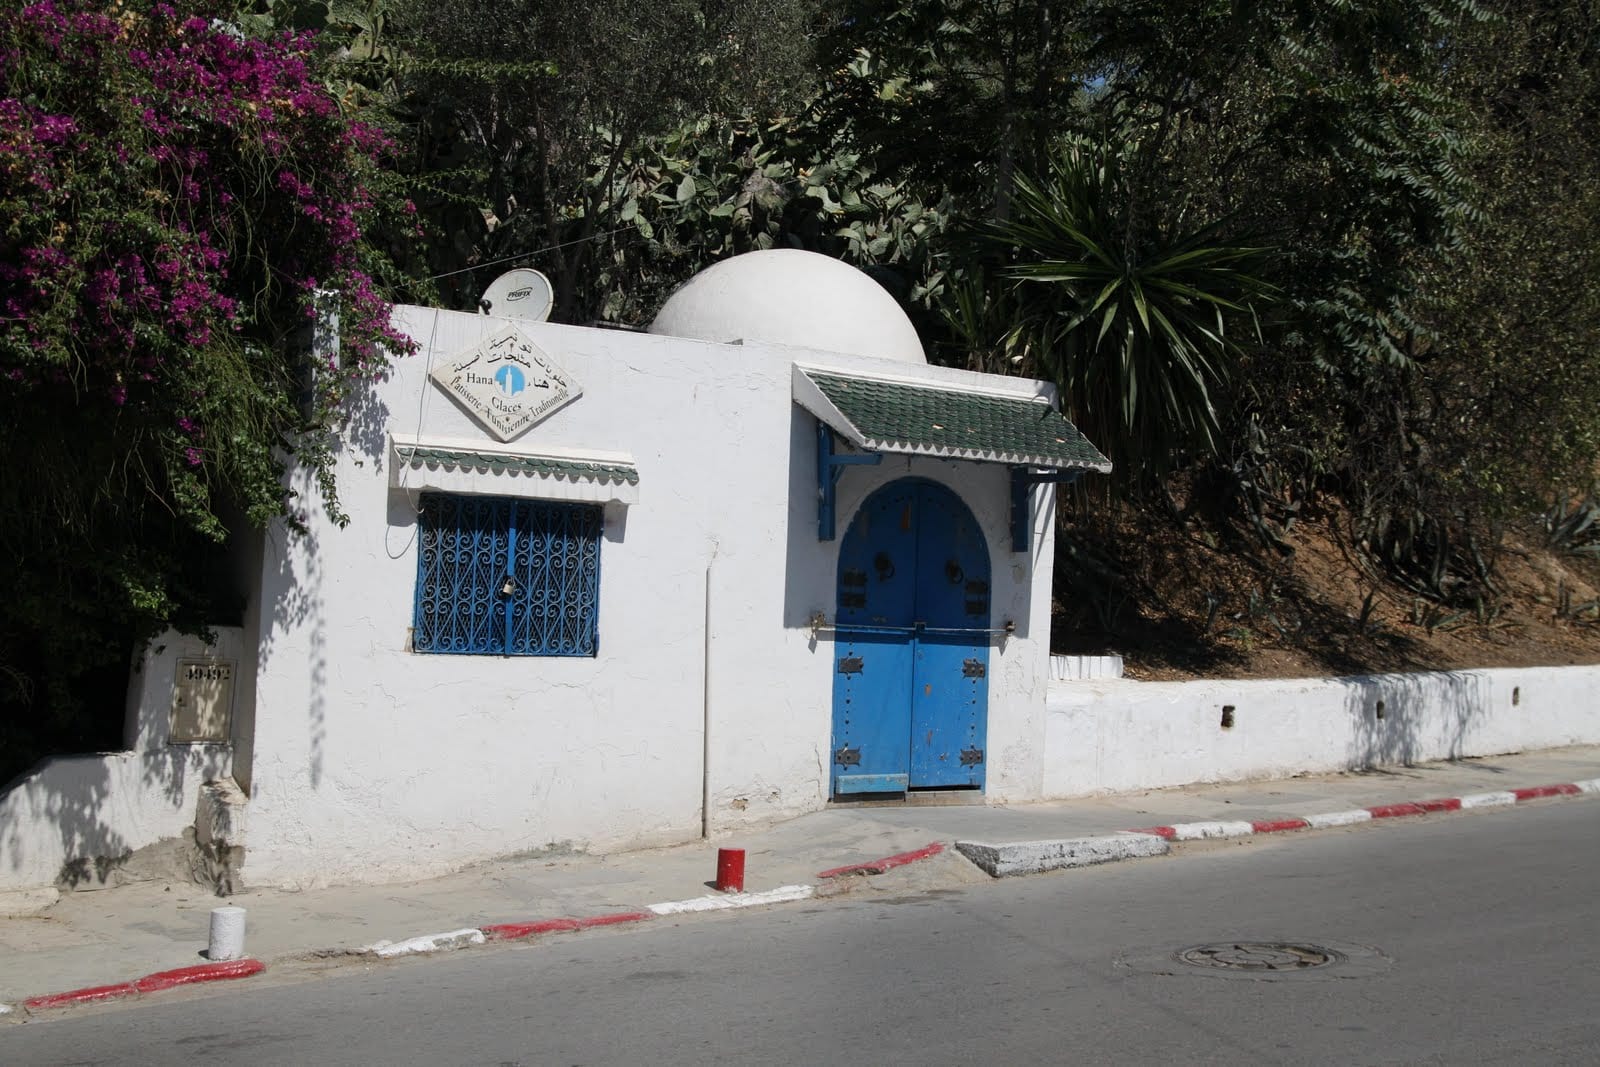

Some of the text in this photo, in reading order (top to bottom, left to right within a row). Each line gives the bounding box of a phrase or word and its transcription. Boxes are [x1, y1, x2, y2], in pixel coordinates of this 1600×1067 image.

[487, 350, 531, 369] مثلجات
[466, 372, 493, 386] Hana
[491, 396, 522, 414] Glaces
[485, 407, 530, 435] Tunisienne
